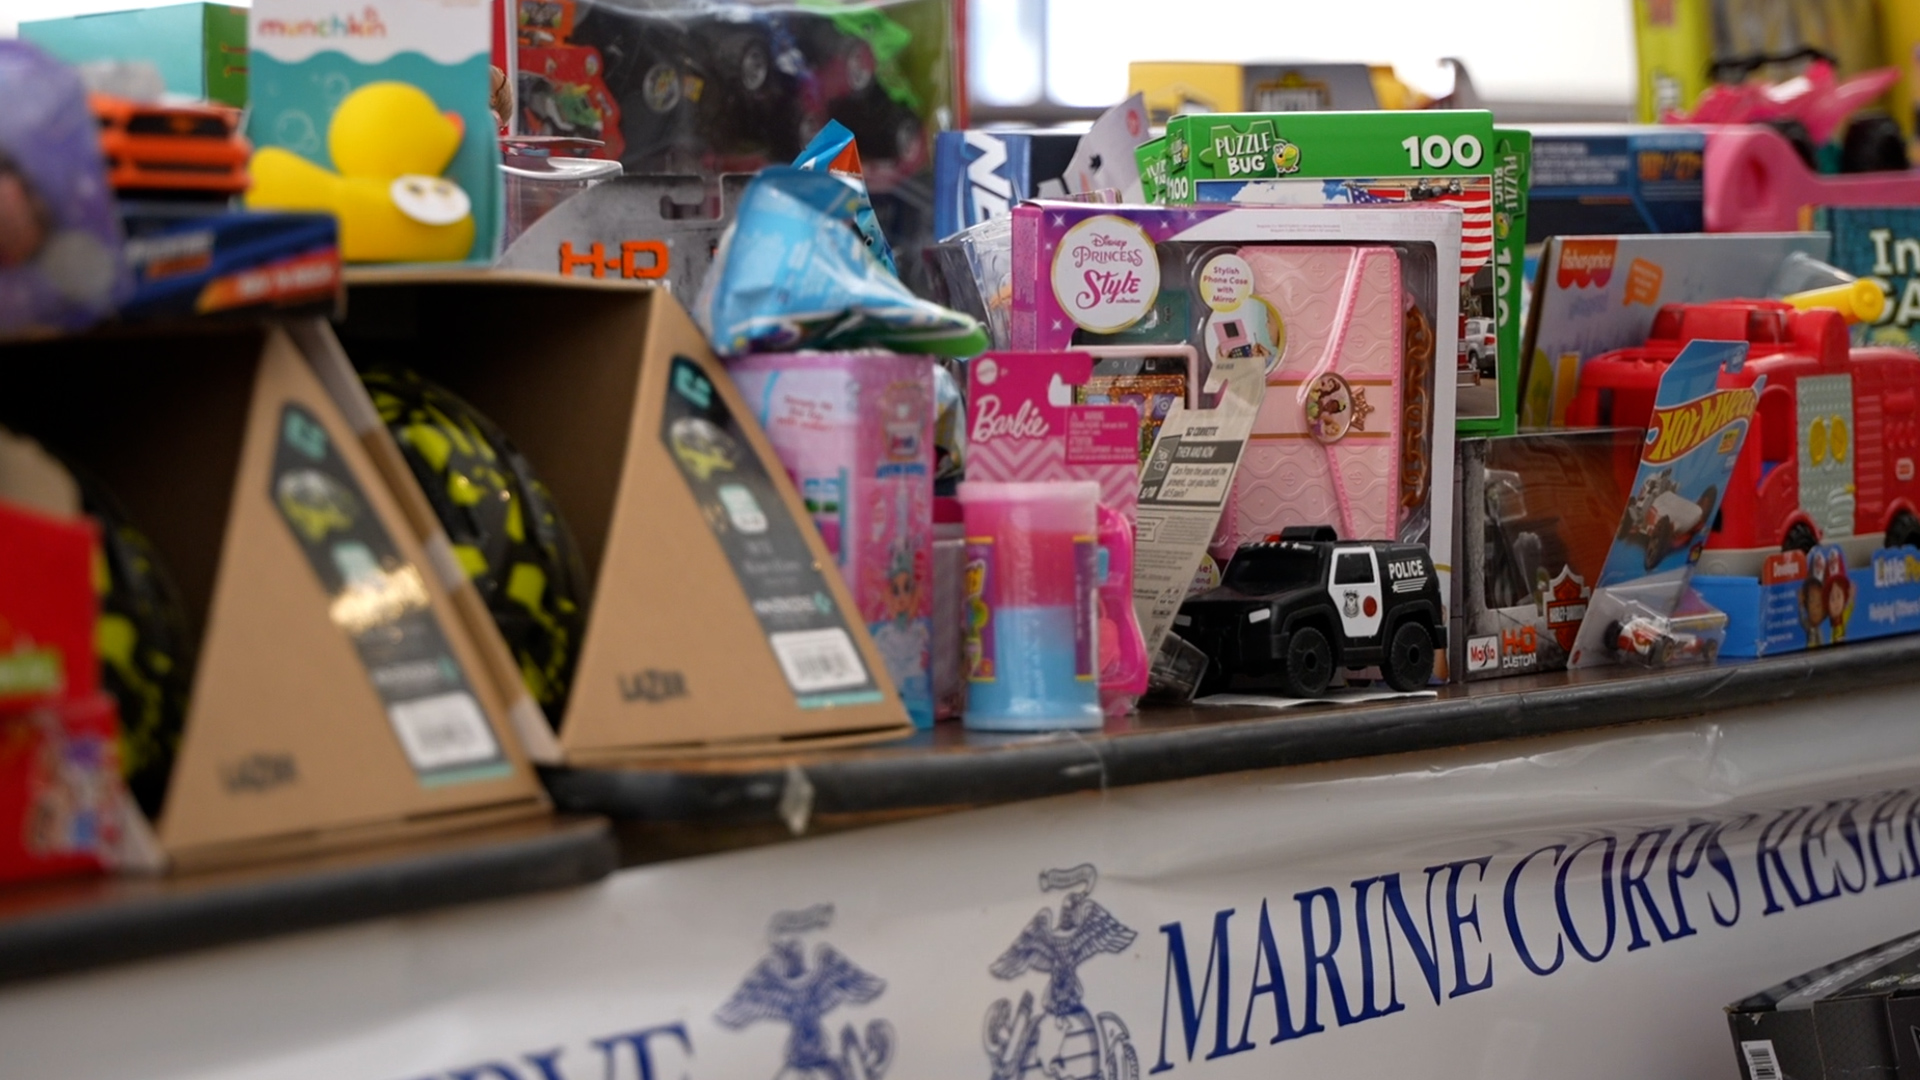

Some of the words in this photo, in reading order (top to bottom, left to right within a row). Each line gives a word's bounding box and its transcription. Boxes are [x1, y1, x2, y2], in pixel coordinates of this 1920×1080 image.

[259, 6, 386, 37] munchkin
[1214, 131, 1271, 158] PUZZLE
[1401, 134, 1483, 168] 100
[1227, 155, 1266, 176] BUG
[1503, 155, 1519, 211] PUZZLE
[1090, 232, 1128, 250] Disney
[560, 240, 669, 278] H-D
[1072, 246, 1143, 268] PRINCESS
[1203, 275, 1227, 284] Phone
[1229, 277, 1248, 285] Case
[1213, 266, 1240, 276] Stylish
[1076, 269, 1141, 310] Style
[1212, 295, 1237, 303] Mirror
[971, 394, 1050, 442] Barbie
[1648, 407, 1700, 460] HOT
[1388, 560, 1424, 580] POLICE
[1470, 640, 1496, 667] Maisto
[1503, 653, 1537, 668] CUSTOM
[1149, 856, 1494, 1075] MARINE
[1503, 812, 1759, 977] CORPS
